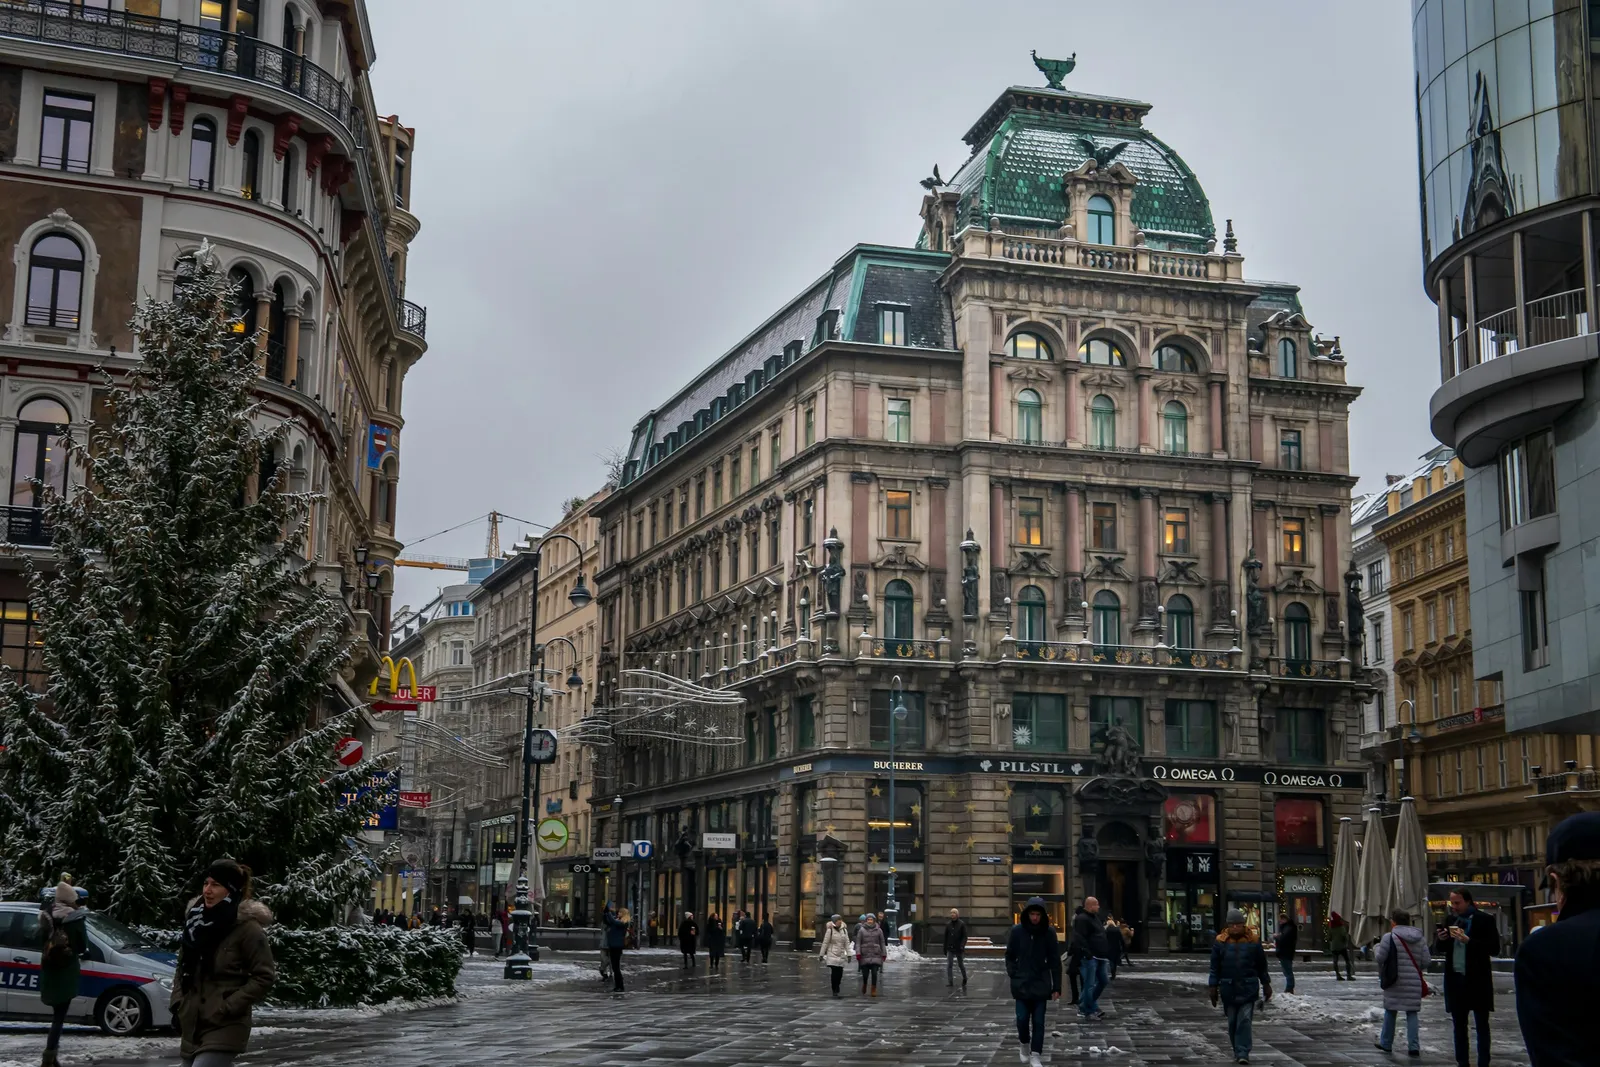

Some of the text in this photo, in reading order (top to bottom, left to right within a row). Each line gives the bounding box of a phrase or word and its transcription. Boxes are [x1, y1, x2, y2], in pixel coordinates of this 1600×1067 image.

[999, 761, 1065, 774] PILSTL
[1170, 768, 1217, 781] OMEGA
[1280, 774, 1326, 786] OMEGA
[594, 850, 620, 858] claire's
[638, 844, 650, 857] U
[1291, 884, 1317, 892] OMEGA
